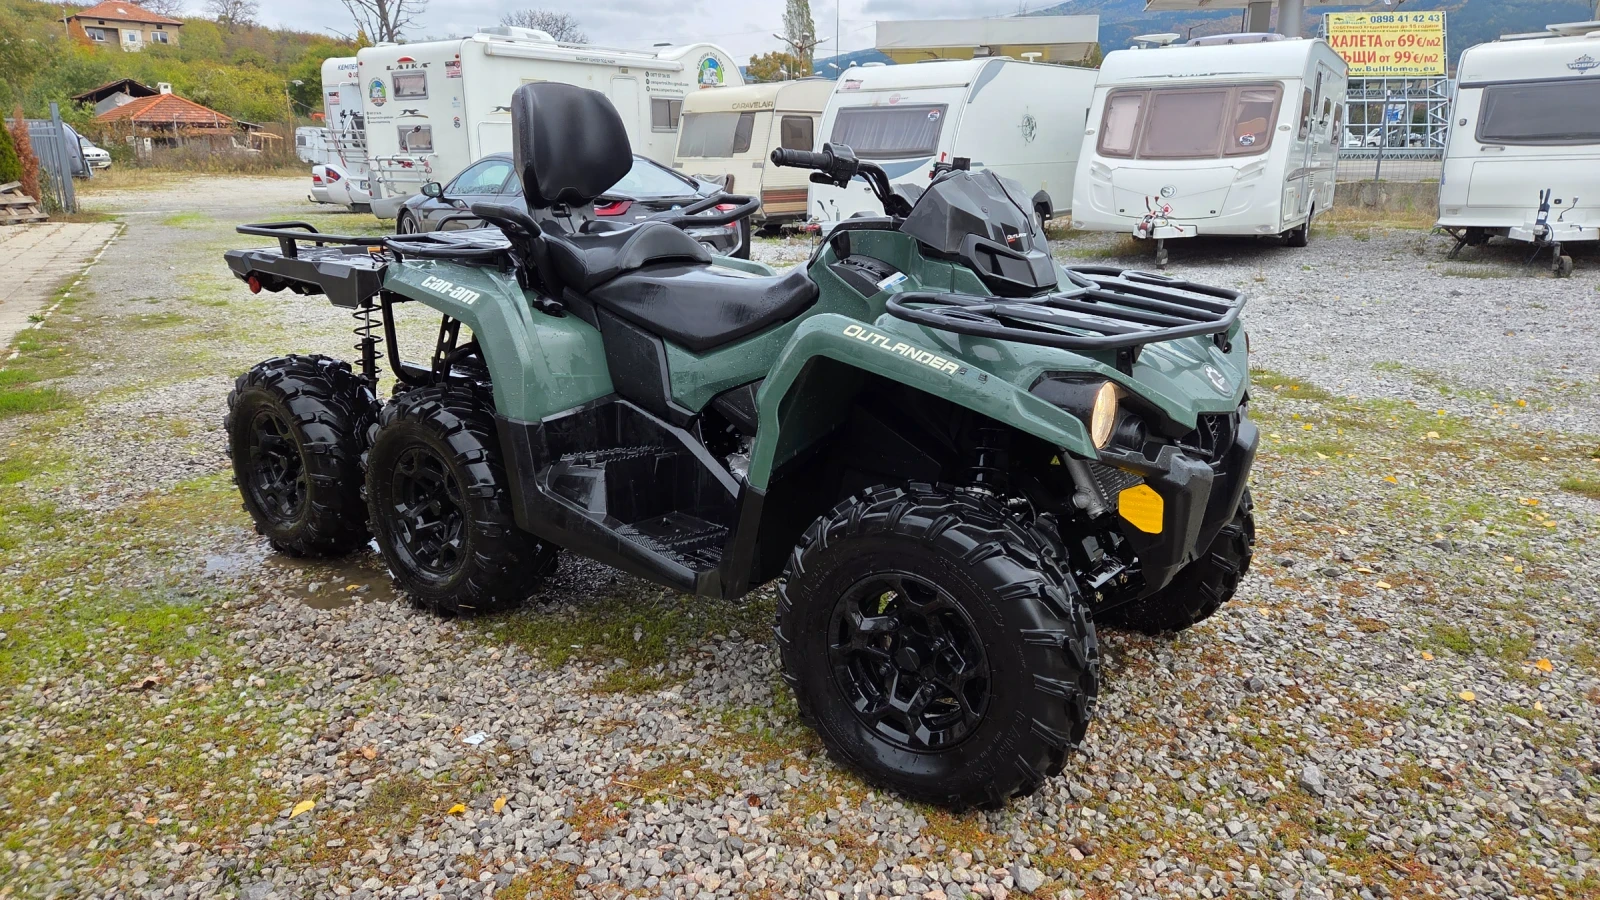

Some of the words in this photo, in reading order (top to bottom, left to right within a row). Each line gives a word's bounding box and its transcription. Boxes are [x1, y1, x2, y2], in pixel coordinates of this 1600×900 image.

[1370, 15, 1395, 23] 0898
[1331, 34, 1383, 48] ХАЛЕТА
[1384, 39, 1396, 47] от
[1337, 50, 1377, 65] ЪЩИ
[1379, 55, 1391, 63] от
[386, 62, 431, 70] LAIKA
[731, 100, 774, 110] CARAVELAIR
[421, 275, 480, 305] can-am
[843, 324, 960, 375] OUTLANDER
